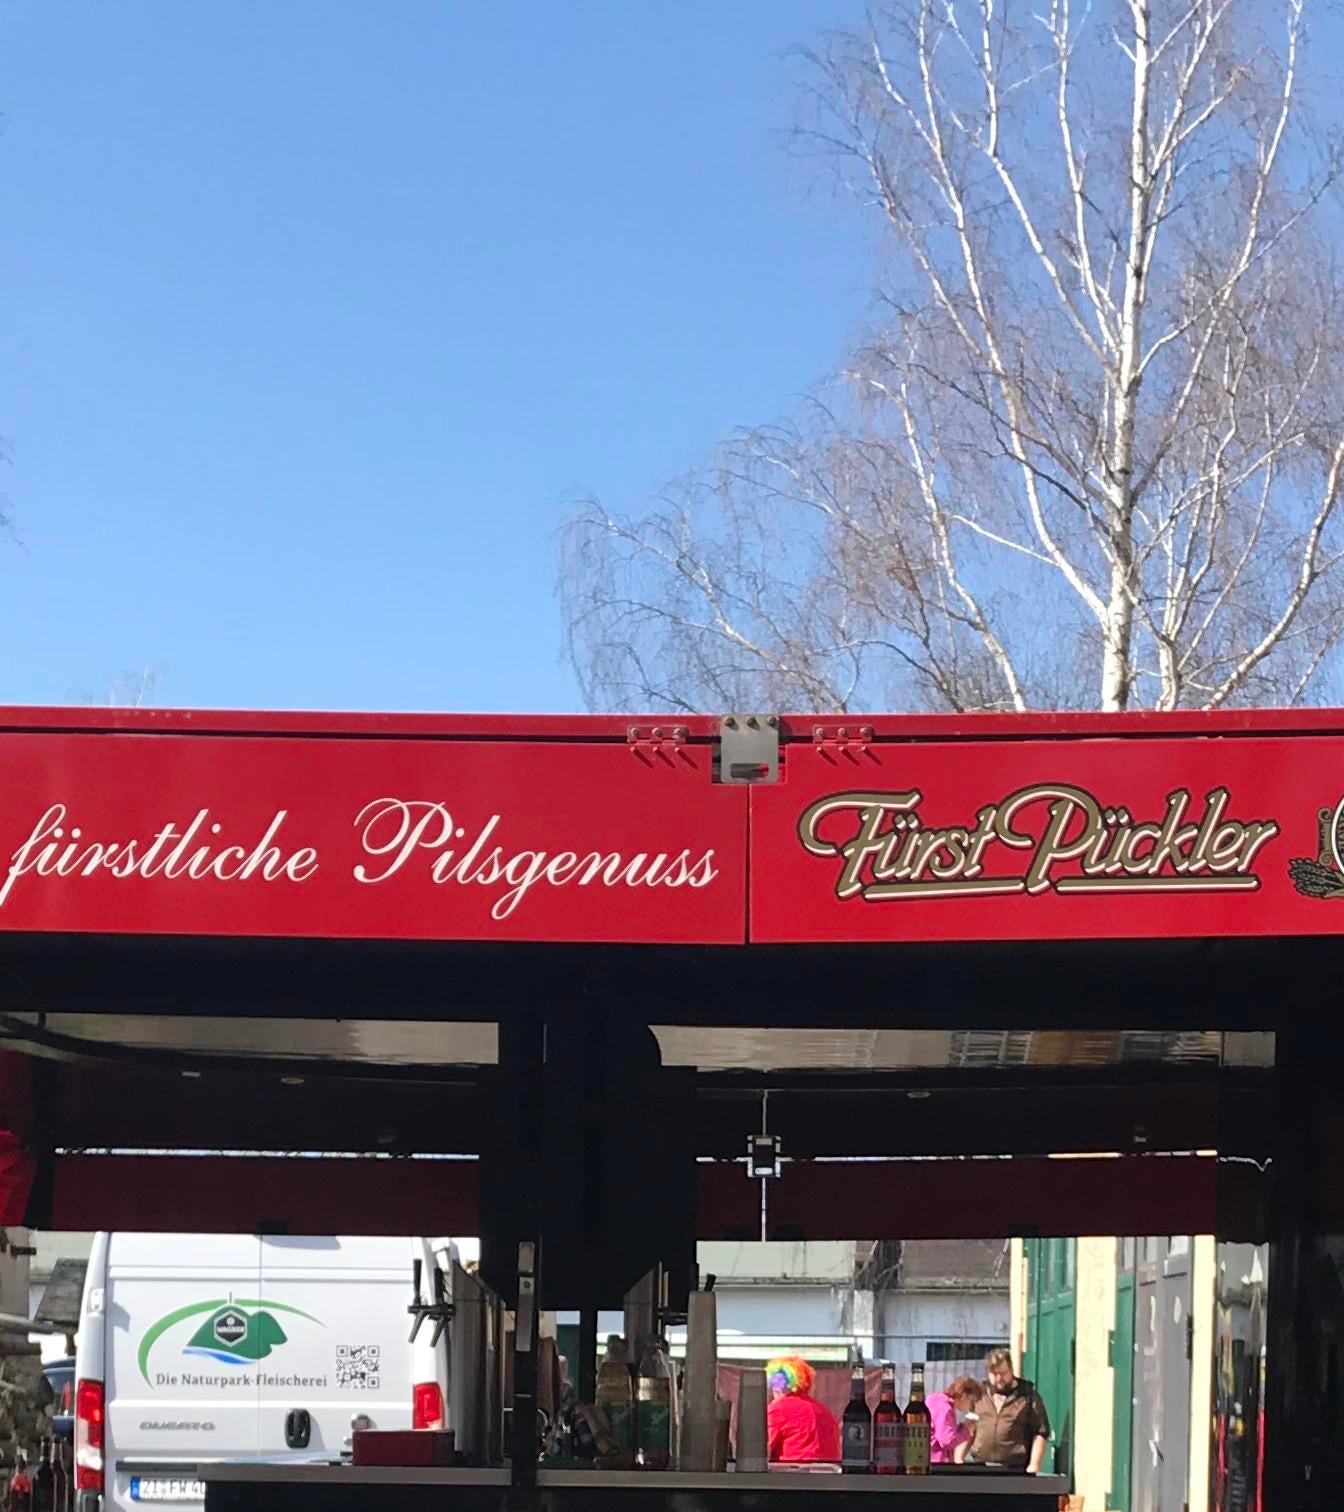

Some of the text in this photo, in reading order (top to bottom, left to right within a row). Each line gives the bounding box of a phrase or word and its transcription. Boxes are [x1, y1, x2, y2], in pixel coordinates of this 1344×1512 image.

[352, 796, 719, 921] Pilsgenuss
[797, 782, 1280, 899] Fürst Pückler
[156, 1373, 177, 1386] Die
